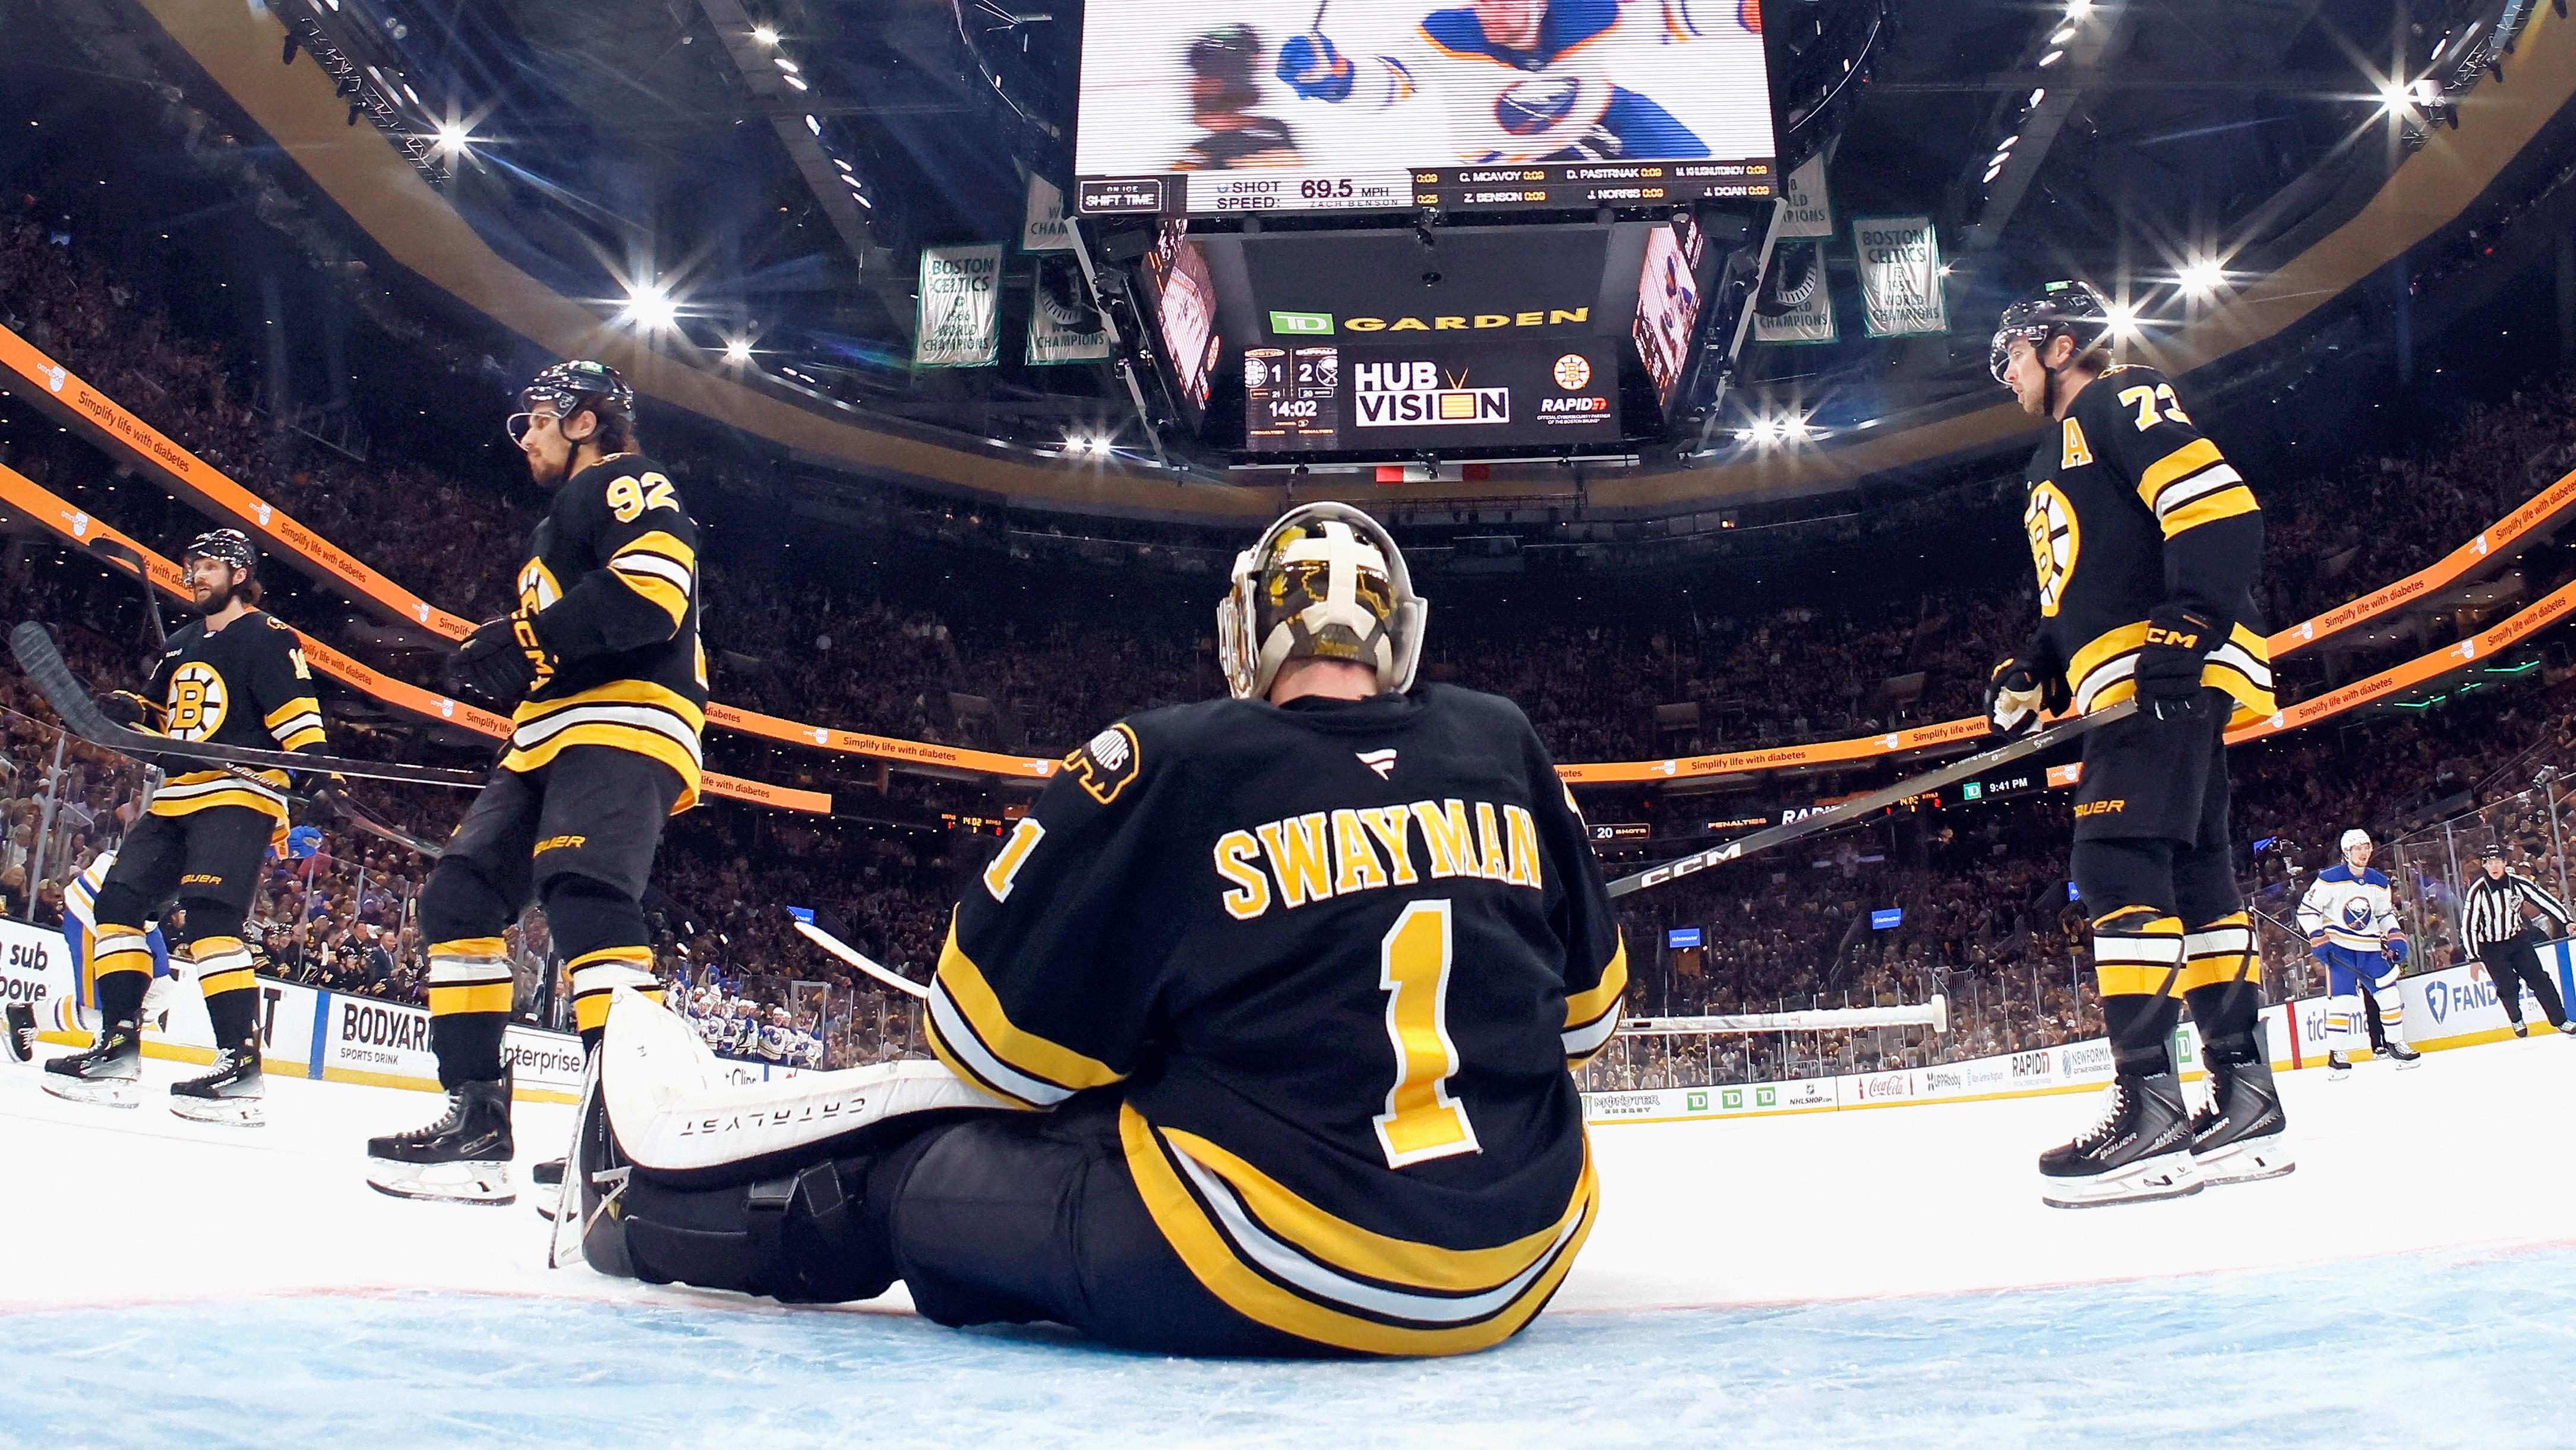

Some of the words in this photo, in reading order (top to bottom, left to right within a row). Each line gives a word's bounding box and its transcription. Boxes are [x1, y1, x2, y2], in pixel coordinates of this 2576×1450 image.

[1472, 170, 1521, 182] MCAVOY
[1580, 168, 1640, 179] PASTRNAK
[1232, 181, 1281, 194] SHOT
[1300, 178, 1353, 199] 69.5
[1361, 187, 1389, 198] MPH
[1476, 192, 1523, 203] BENSON
[1598, 188, 1641, 199] NORRIS
[1715, 186, 1747, 197] DOAN
[1085, 194, 1122, 207] SHIFT
[1123, 193, 1155, 206] TIME
[1217, 196, 1280, 210] SPEED:
[1348, 198, 1399, 207] BENSON
[1862, 229, 1925, 245] BOSTON
[932, 257, 995, 275] BOSTON
[1868, 247, 1927, 264] CELTICS
[933, 276, 989, 293] CELTICS
[1274, 315, 1330, 331] TD
[1344, 307, 1589, 331] GARDEN
[1760, 313, 1827, 327] CHAMPIONS
[1037, 333, 1104, 349] CHAMPIONS
[1271, 364, 1281, 383] 1
[1299, 363, 1313, 382] 2
[1355, 361, 1438, 391] HUB
[1268, 400, 1318, 418] 14:02
[2117, 383, 2192, 432] 73
[78, 390, 117, 427] Simplify
[117, 415, 132, 435] life
[132, 428, 153, 449] with
[153, 441, 190, 472] diabetes
[2060, 416, 2094, 470] A
[606, 470, 680, 524] 92
[2496, 517, 2523, 541] Simplify
[2522, 508, 2534, 523] life
[2534, 498, 2549, 517] with
[280, 522, 311, 551] Simplify
[310, 539, 322, 556] life
[323, 549, 338, 566] with
[338, 558, 367, 584] diabetes
[152, 562, 170, 581] with
[2325, 608, 2356, 628] Simplify
[2356, 602, 2370, 615] life
[2370, 594, 2389, 609] with
[2389, 579, 2425, 601] diabetes
[2487, 626, 2512, 647] Simplify
[2512, 617, 2524, 633] life
[2524, 611, 2538, 627] with
[2538, 596, 2566, 618] diabetes
[2144, 627, 2198, 649] CM
[318, 649, 330, 664] life
[330, 656, 345, 671] with
[345, 664, 372, 685] diabetes
[169, 681, 207, 729] B
[2299, 699, 2328, 719] Simplify
[2328, 694, 2341, 707] life
[2341, 687, 2359, 702] with
[2359, 677, 2393, 695] diabetes
[466, 711, 498, 733] Simplify
[499, 721, 512, 735] life
[705, 706, 741, 723] diabetes
[1913, 729, 1949, 743] Simplify
[1949, 725, 1964, 735] life
[1966, 721, 1985, 733] with
[844, 736, 880, 752] Simplify
[882, 742, 896, 753] life
[897, 745, 918, 757] with
[918, 748, 956, 762] diabetes
[1691, 759, 1728, 771] Simplify
[1729, 757, 1744, 766] life
[1745, 754, 1766, 765] with
[1767, 750, 1807, 762] diabetes
[1557, 769, 1583, 778] betes
[700, 775, 715, 787] life
[715, 778, 734, 791] with
[735, 784, 771, 799] diabetes
[1966, 785, 1980, 797] TD
[1990, 779, 2010, 792] 9:41
[2012, 778, 2028, 789] PM
[1596, 827, 1614, 839] 20
[1615, 827, 1647, 836] SHOTS
[1707, 817, 1767, 830] PENALTIES
[983, 816, 1046, 902] 1
[1214, 799, 1542, 920] SWAYMAN
[1640, 842, 1742, 888] CCM
[10, 941, 48, 971] sub
[2527, 1001, 2538, 1012] 21+
[342, 1002, 433, 1053] BODYAR
[1372, 897, 1480, 1169] 1
[340, 1047, 373, 1063] SPORTS
[374, 1051, 399, 1066] DRINK
[1594, 1095, 1660, 1108] MONSTER
[1688, 1095, 1706, 1107] TD
[1723, 1092, 1741, 1105] TD
[1757, 1090, 1775, 1103] TD
[679, 1097, 866, 1136] CATALYST
